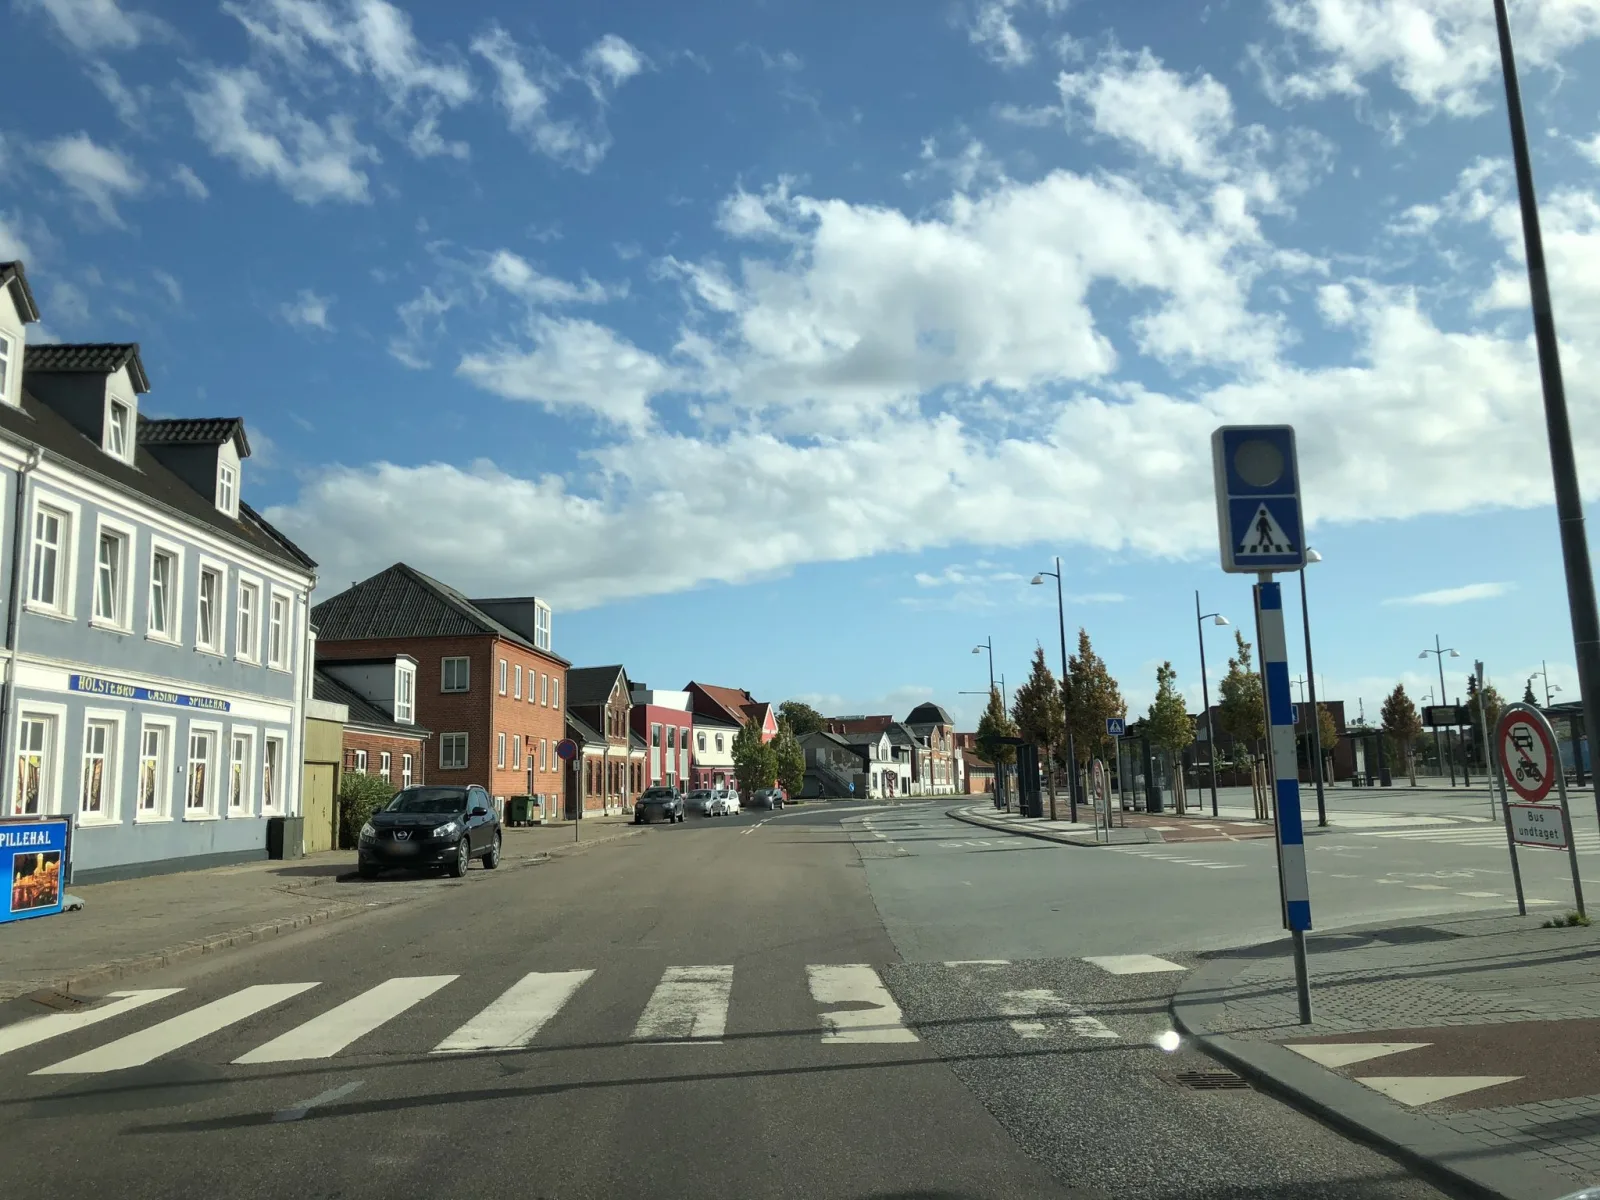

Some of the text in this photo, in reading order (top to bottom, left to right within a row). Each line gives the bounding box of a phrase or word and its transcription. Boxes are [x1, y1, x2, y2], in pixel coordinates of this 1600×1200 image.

[78, 675, 227, 711] HOLSTEBRO CASINO SPILLEHAL
[1527, 811, 1545, 823] Bus
[1518, 826, 1560, 840] undtaget
